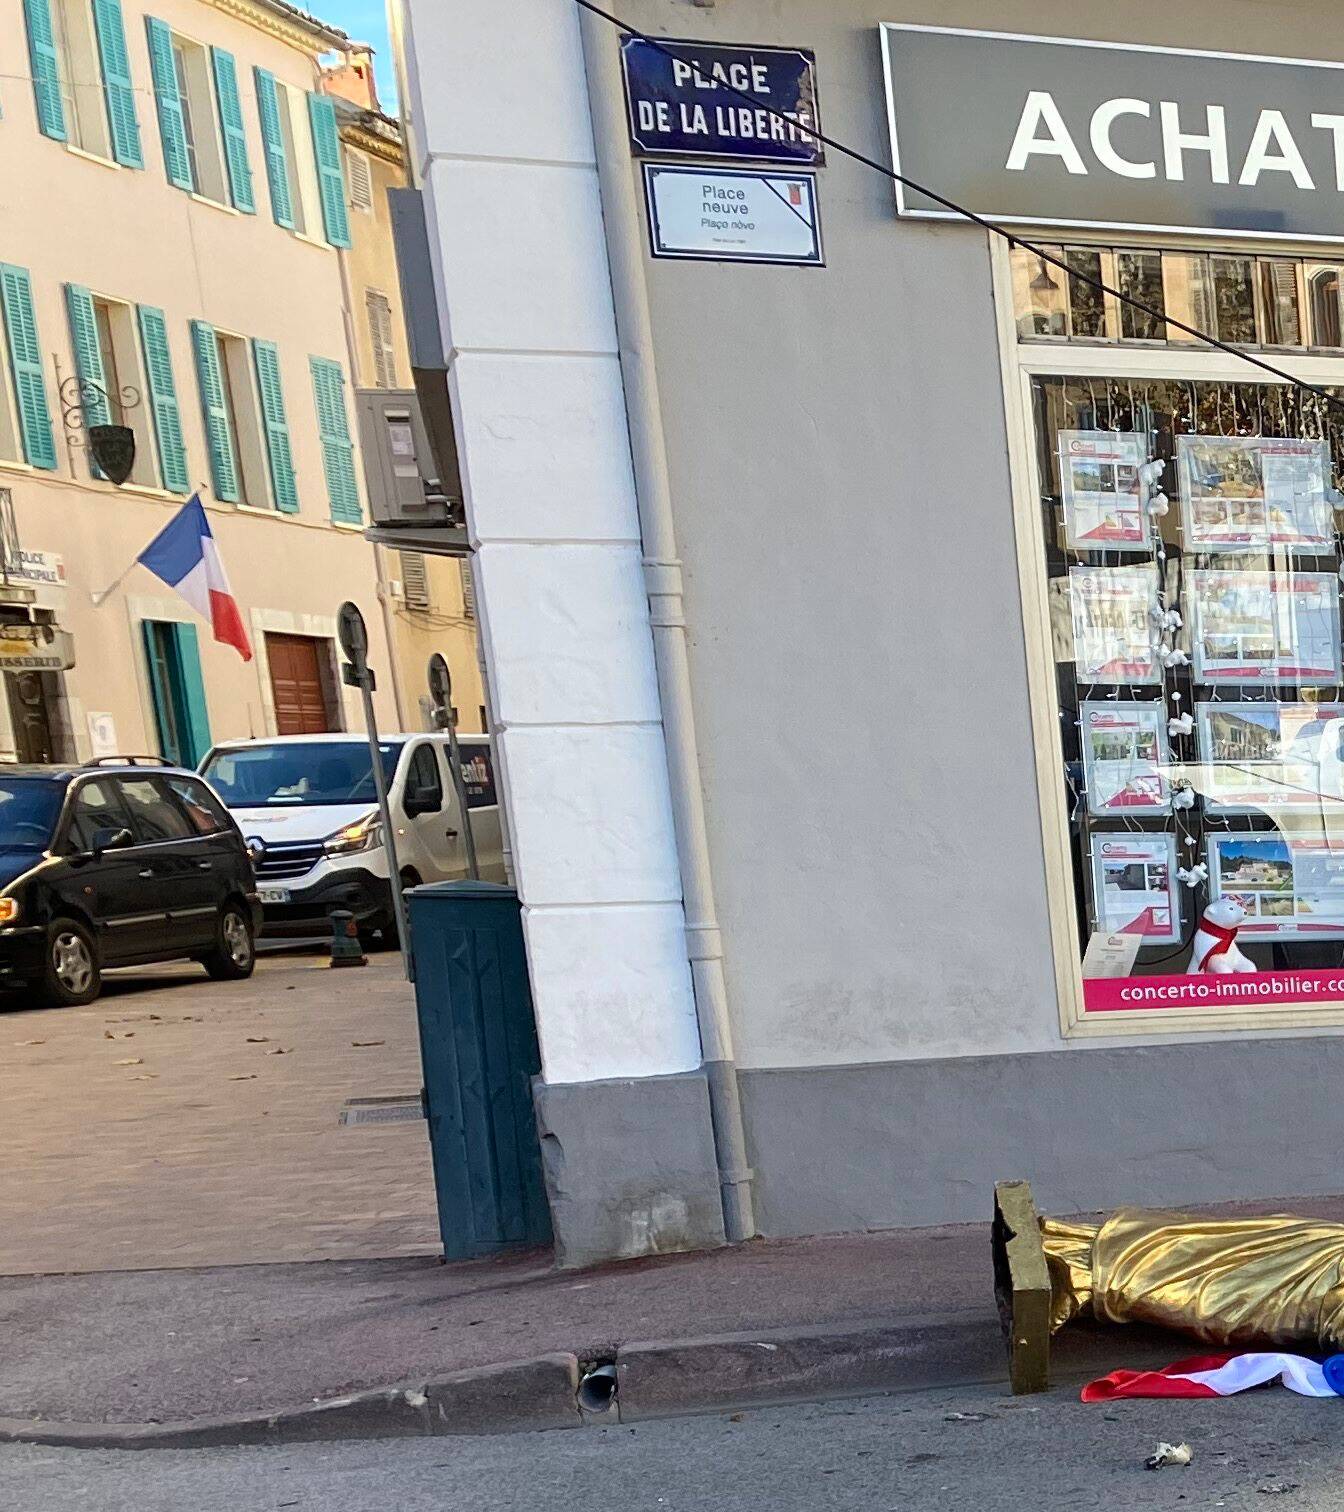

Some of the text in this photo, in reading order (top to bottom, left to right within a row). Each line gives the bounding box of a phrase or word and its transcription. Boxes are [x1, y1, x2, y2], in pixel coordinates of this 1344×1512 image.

[672, 58, 771, 94] PLACE
[638, 100, 671, 133] DE
[680, 102, 709, 136] LA
[702, 185, 746, 201] Place
[702, 201, 749, 215] neuve
